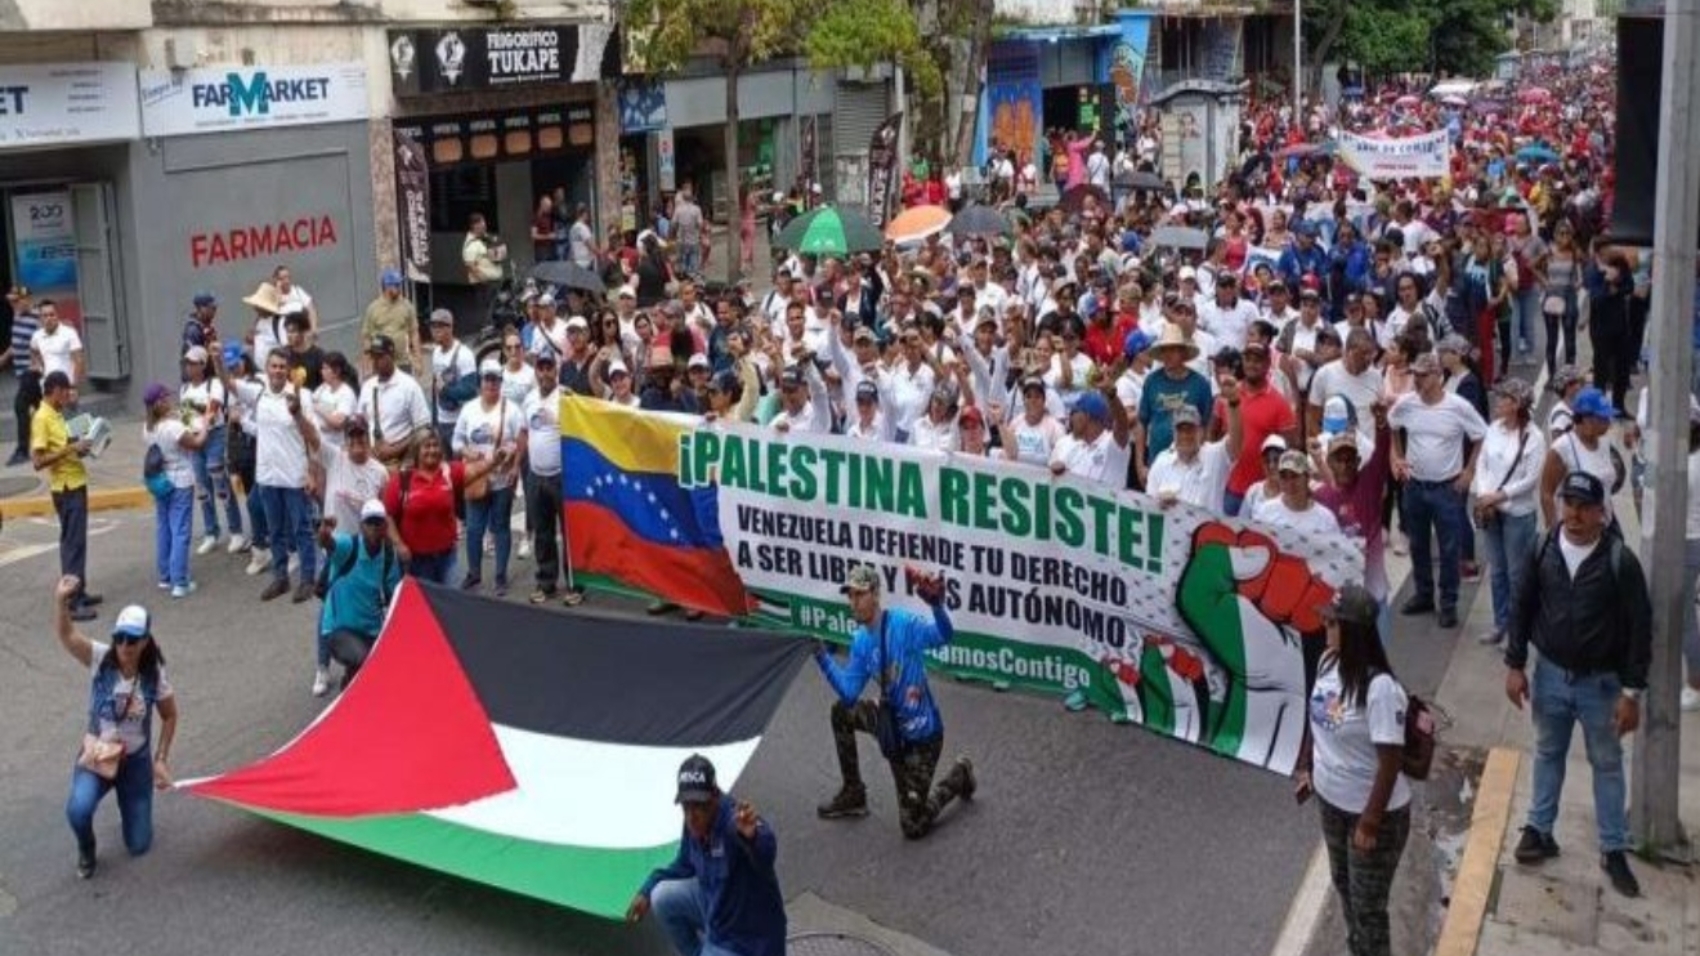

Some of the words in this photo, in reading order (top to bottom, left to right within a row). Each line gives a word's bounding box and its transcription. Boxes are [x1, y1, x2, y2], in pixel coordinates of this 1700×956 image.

[193, 71, 330, 117] FARMARKET
[488, 48, 560, 74] TUKAPE
[191, 214, 338, 268] FARMACIA
[737, 503, 854, 550] VENEZUELA
[858, 522, 965, 572] DEFIENDE
[970, 544, 1005, 577] TU
[1010, 551, 1128, 608] DERECHO
[938, 466, 1165, 575] RESISTE!
[738, 540, 753, 569] A
[757, 544, 804, 578] SER
[882, 563, 899, 593] Y
[968, 582, 1126, 648] AUTÓNOMO
